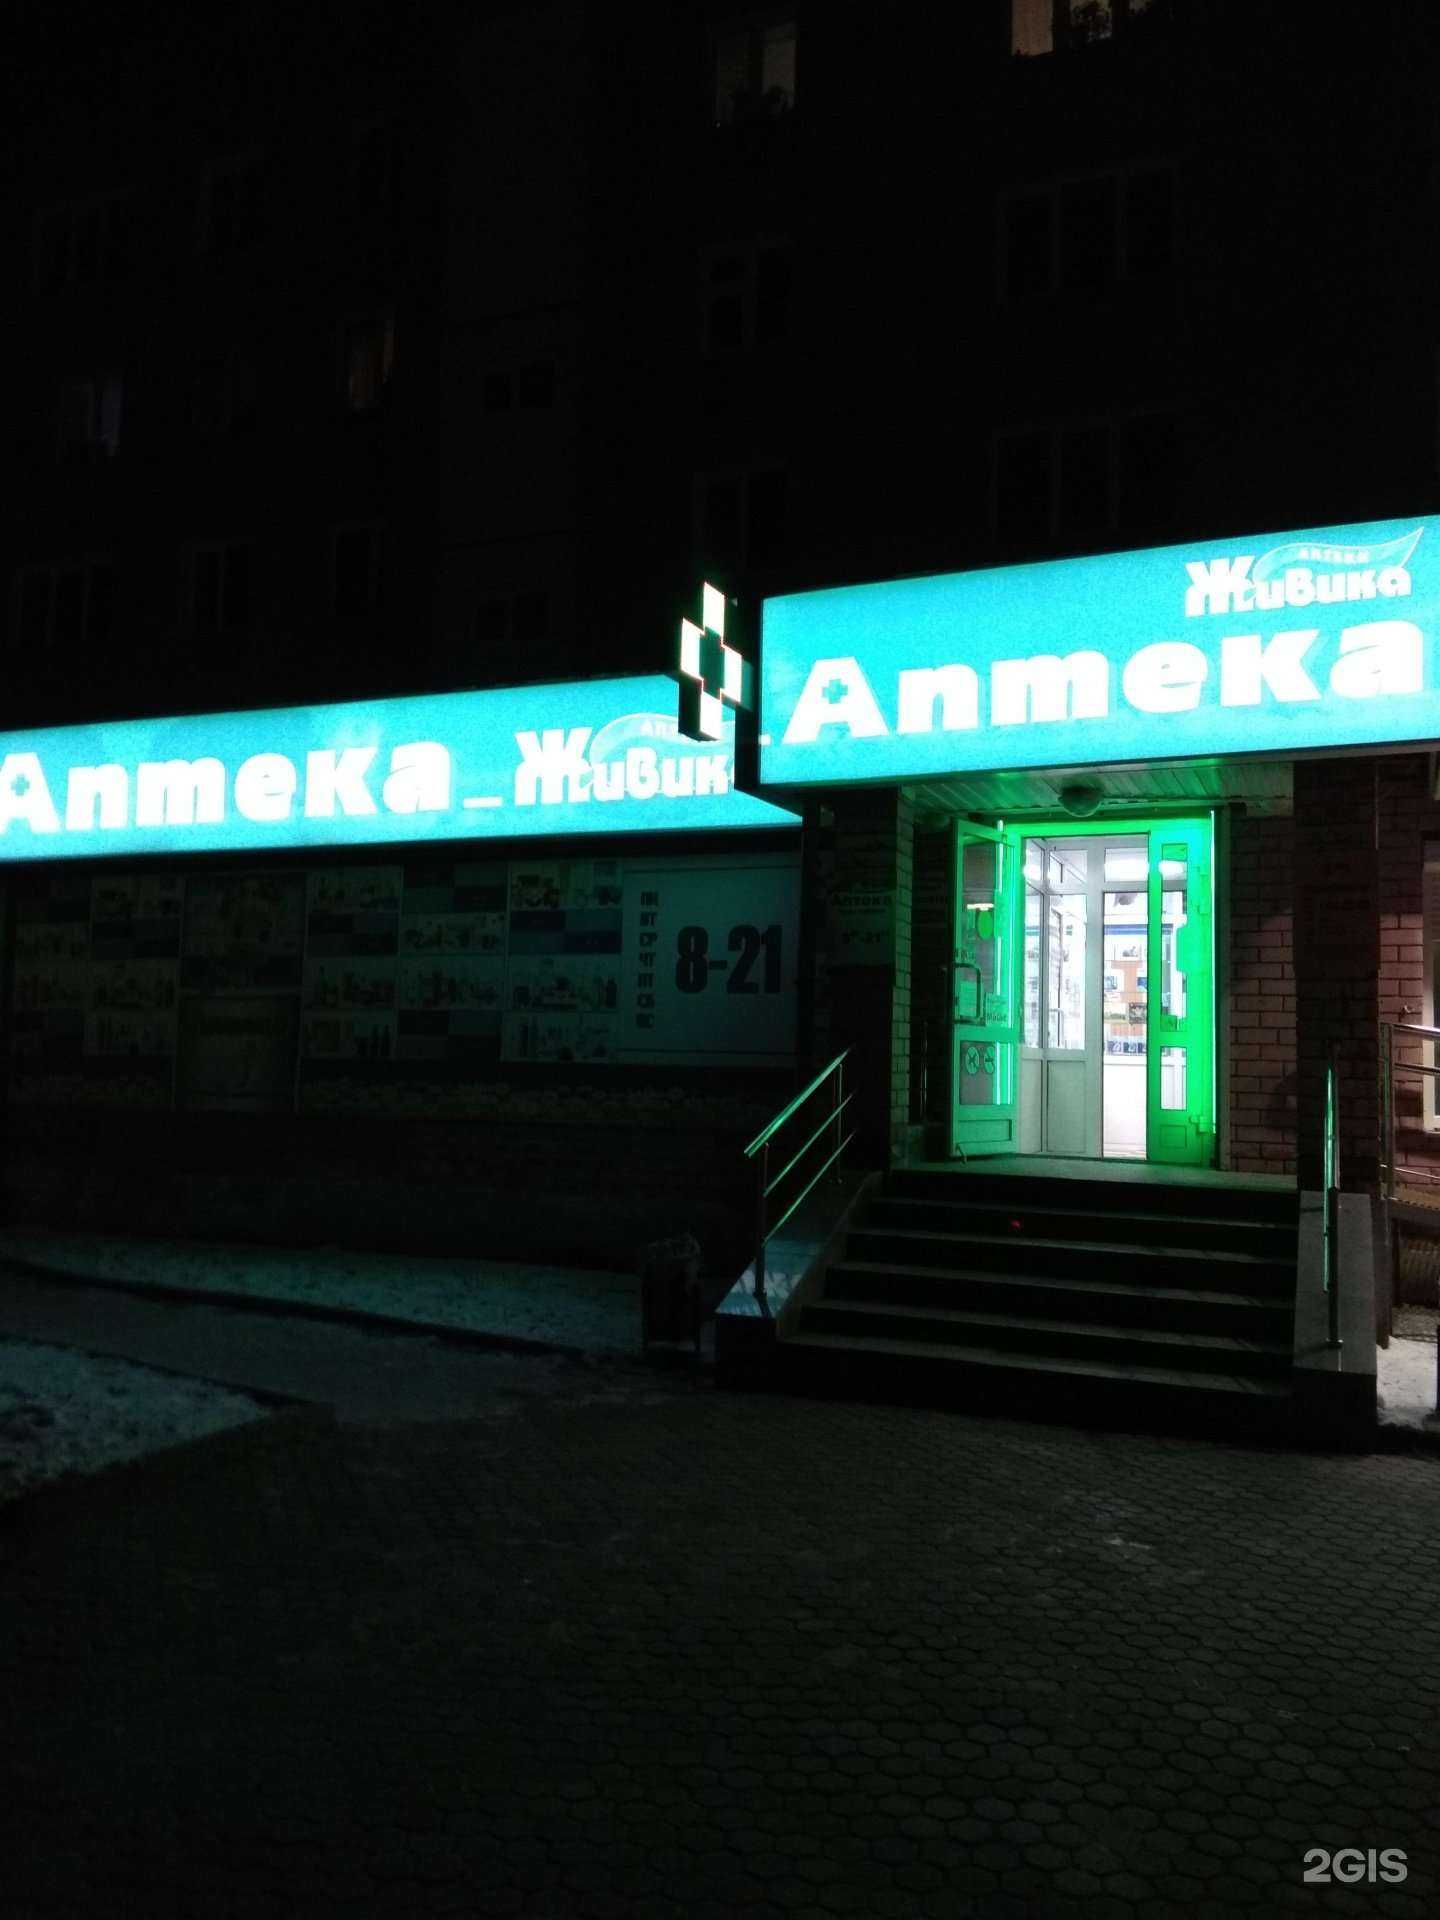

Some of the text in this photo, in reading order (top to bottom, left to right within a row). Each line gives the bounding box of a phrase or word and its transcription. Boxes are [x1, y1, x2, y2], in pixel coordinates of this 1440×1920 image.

[1185, 554, 1412, 617] Живика
[782, 619, 1423, 745] Аптека
[0, 740, 451, 835] Аптека
[514, 727, 735, 807] Живик
[676, 924, 782, 993] 8-21
